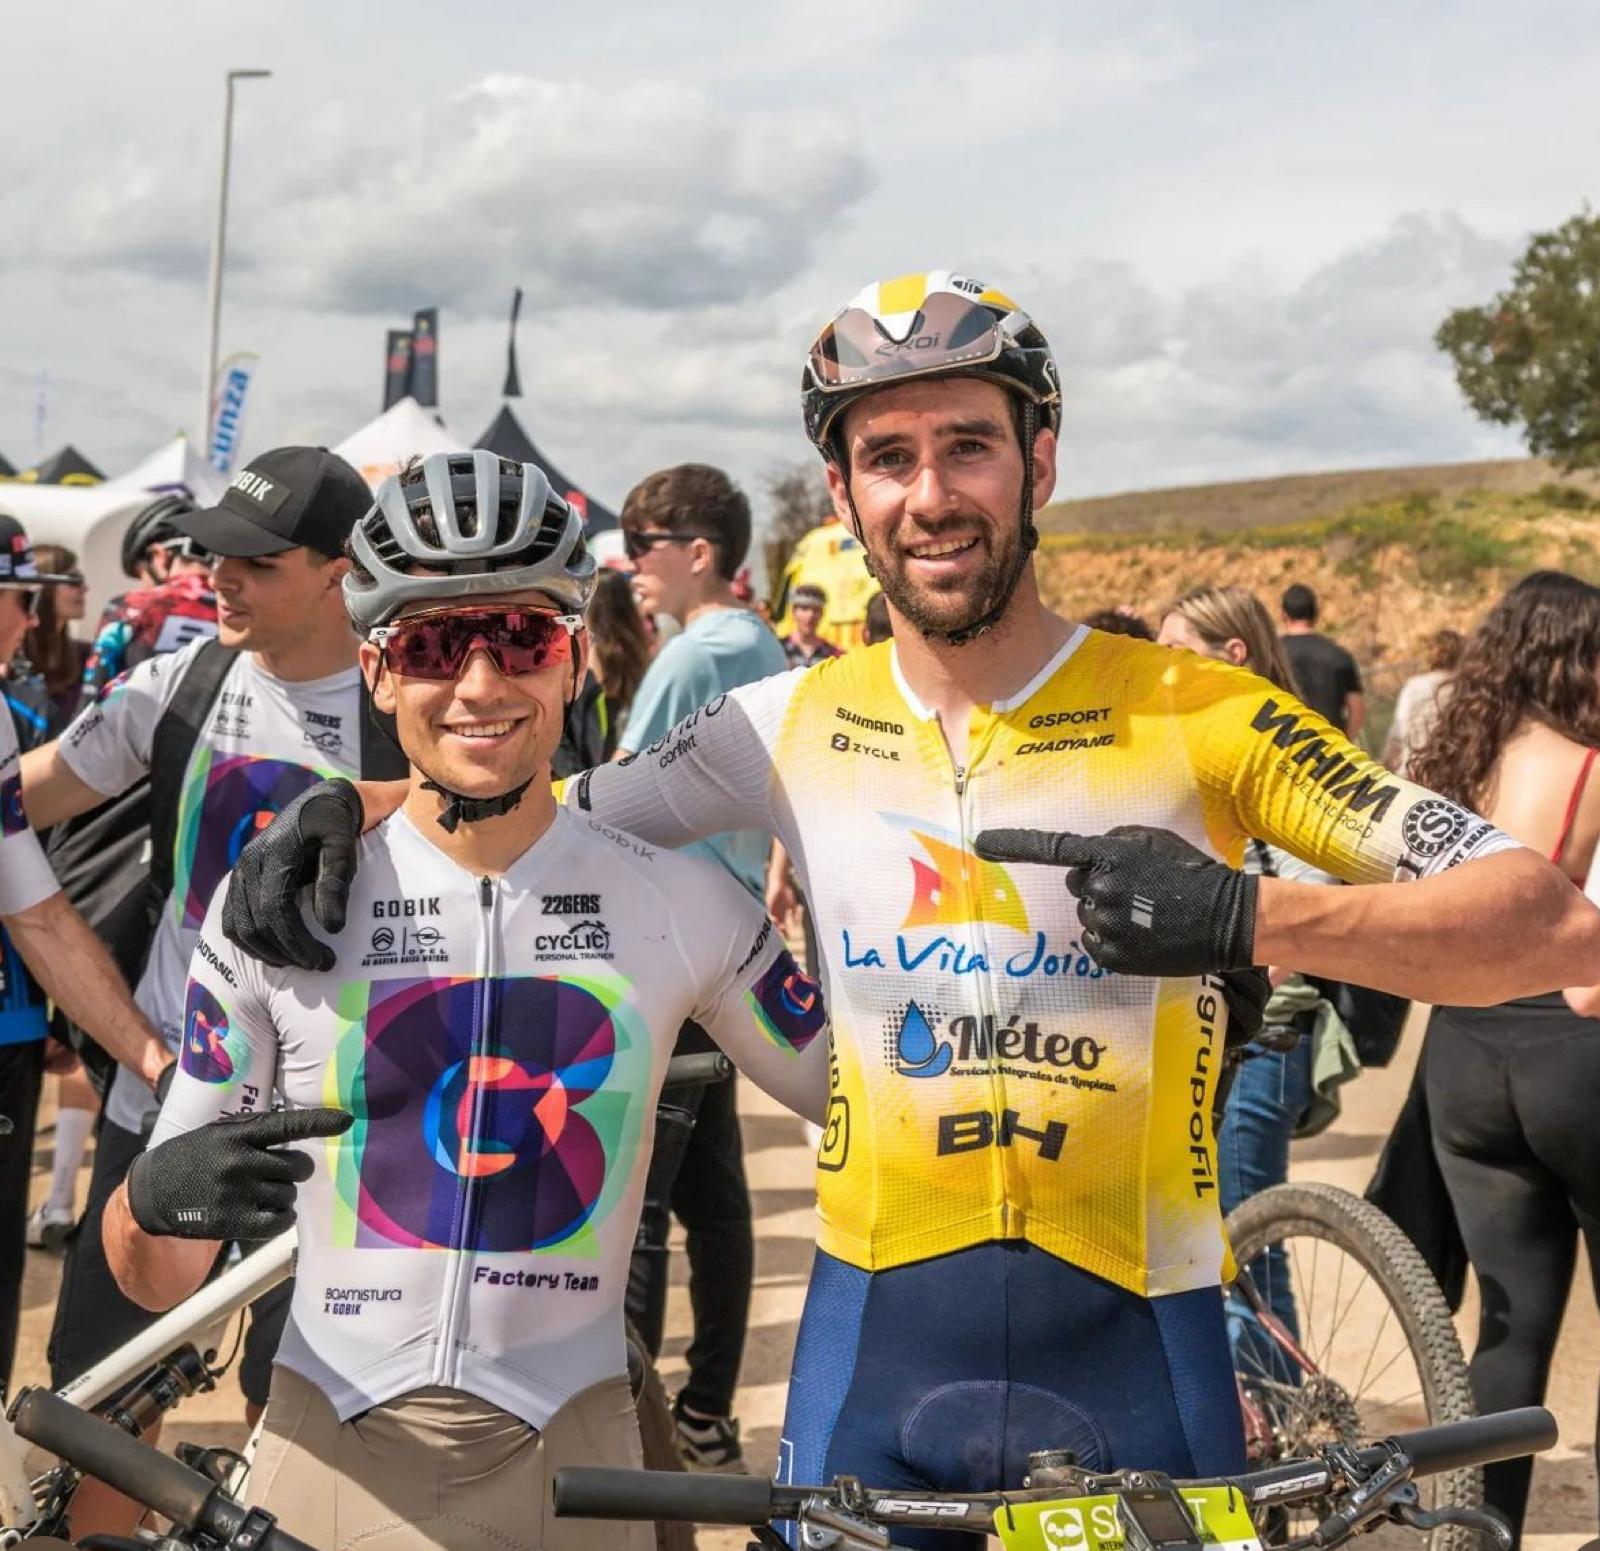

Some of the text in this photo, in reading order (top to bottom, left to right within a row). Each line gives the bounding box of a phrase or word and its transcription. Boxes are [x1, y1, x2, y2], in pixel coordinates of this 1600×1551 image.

[835, 707, 905, 737] SHIMANO
[1029, 707, 1112, 730] GSPORT
[852, 743, 901, 762] ZYCLE
[1015, 733, 1116, 757] CHAOYANG
[1250, 698, 1401, 824] WHIM
[373, 897, 441, 918] GOBIK
[541, 894, 601, 915] 226ERS
[535, 951, 615, 962] PERSONAL TRAINER
[842, 929, 1114, 979] La Vila Joiò
[949, 1014, 1108, 1071] Néteo
[937, 1109, 1069, 1162] BH
[473, 1266, 599, 1291] Factory Team
[332, 1303, 361, 1316] GOBIK
